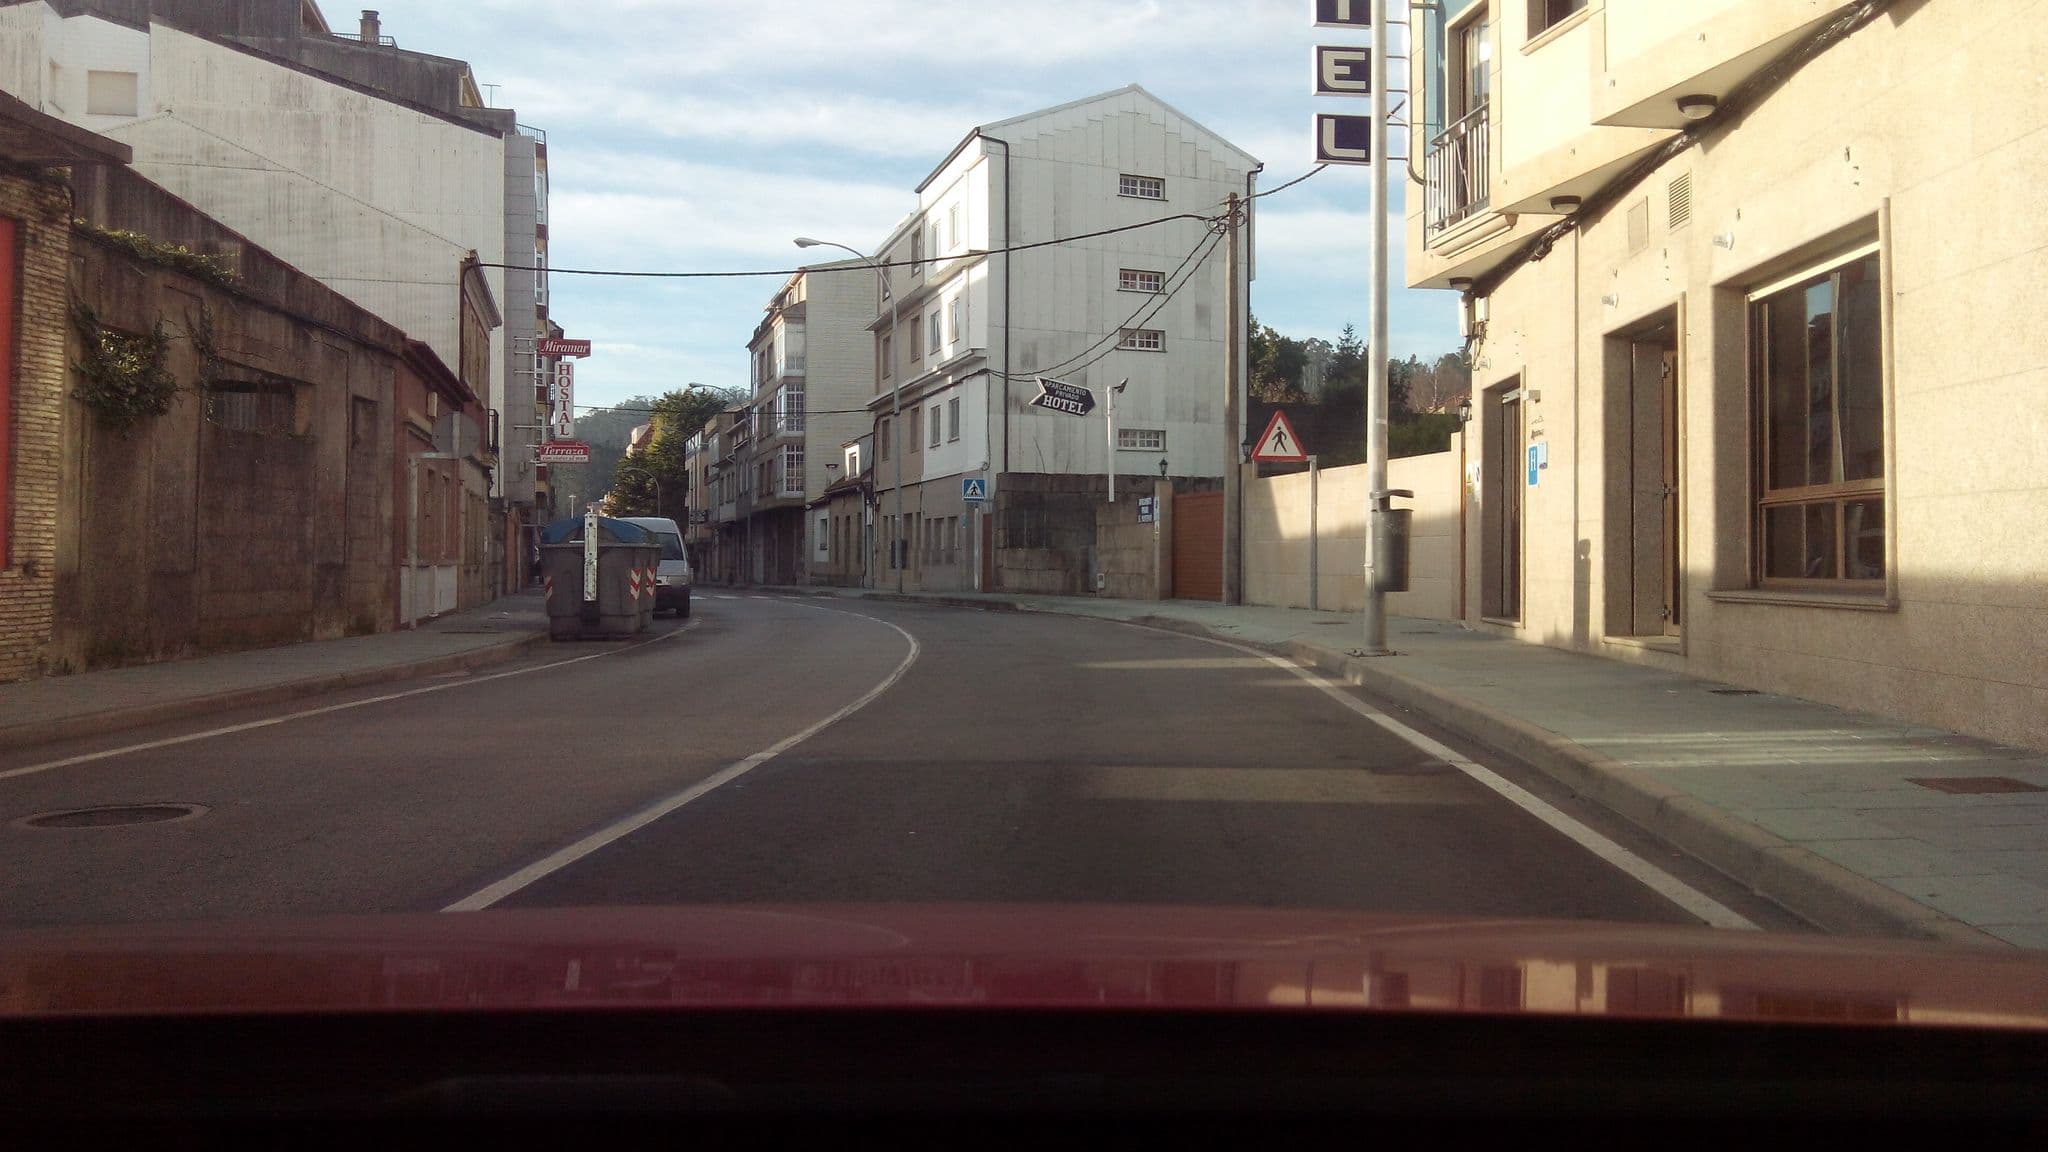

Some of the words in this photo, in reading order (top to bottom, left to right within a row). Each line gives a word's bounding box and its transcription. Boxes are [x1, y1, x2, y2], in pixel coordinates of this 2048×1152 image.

[541, 340, 589, 353] Miramar
[558, 364, 571, 436] HOSTAL
[1042, 394, 1085, 415] HOTEL
[543, 446, 584, 455] Terraza
